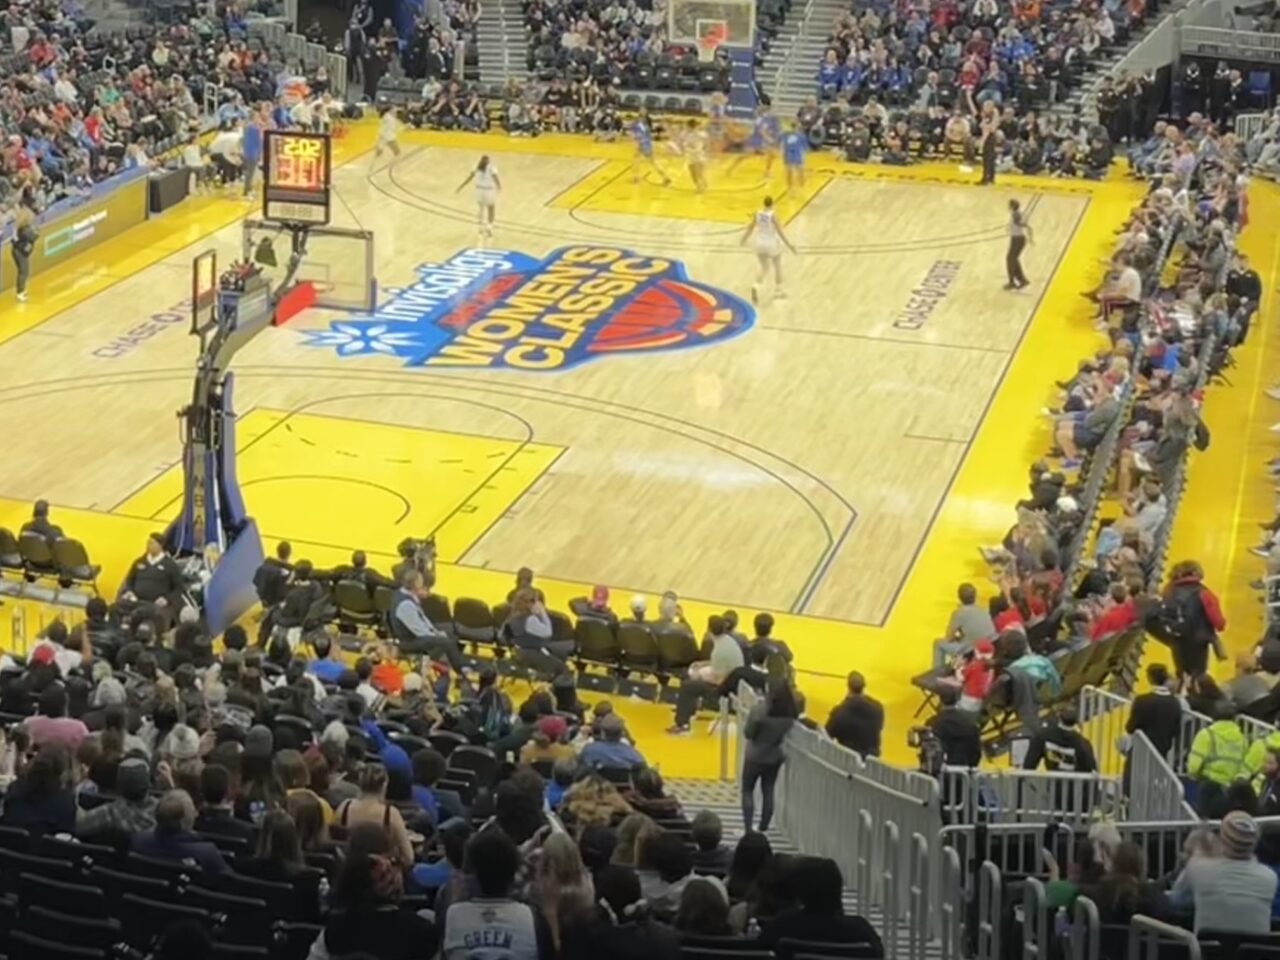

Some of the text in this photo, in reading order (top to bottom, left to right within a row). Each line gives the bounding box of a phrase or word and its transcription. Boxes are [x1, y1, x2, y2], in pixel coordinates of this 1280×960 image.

[374, 248, 513, 323] invisalign
[504, 257, 670, 370] CLASSIC
[463, 929, 513, 950] GREEN
